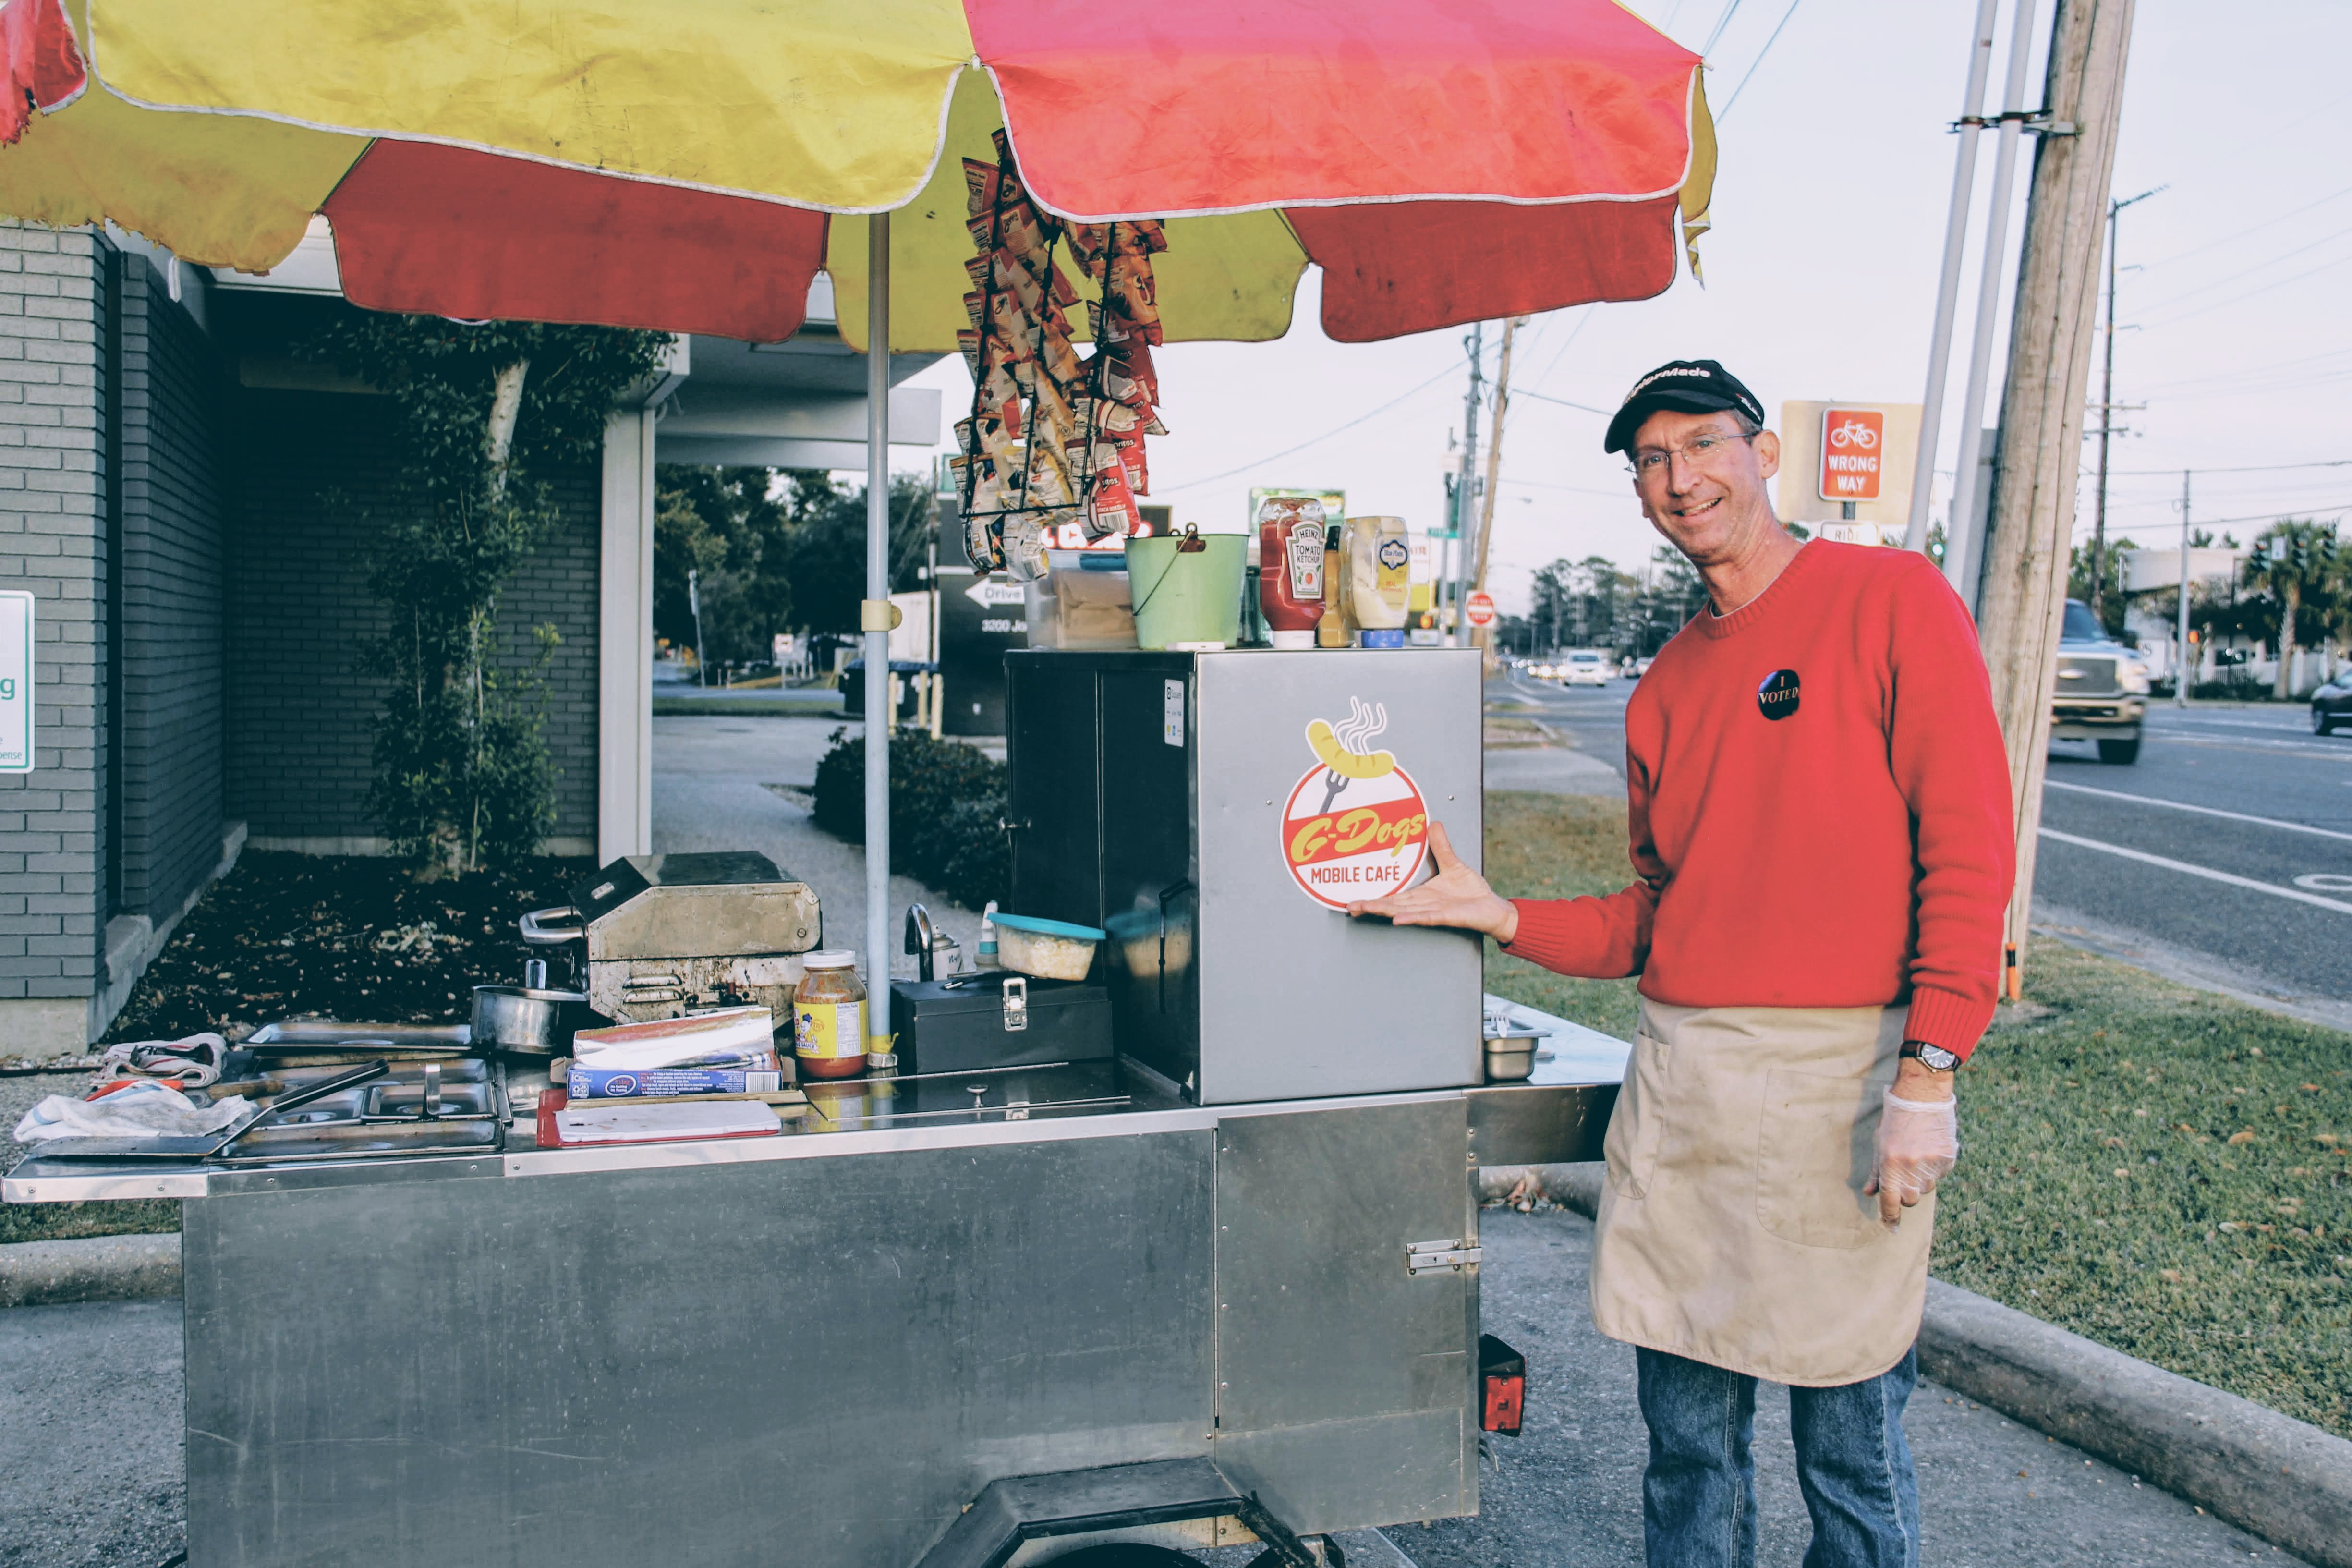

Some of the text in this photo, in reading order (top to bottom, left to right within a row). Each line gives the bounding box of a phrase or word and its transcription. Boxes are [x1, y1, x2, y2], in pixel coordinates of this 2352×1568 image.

[1828, 455, 1877, 472] WRONG
[1837, 476, 1866, 492] WAY
[1299, 530, 1318, 540] HEINZ
[1296, 545, 1320, 555] TOMATO
[1297, 555, 1320, 563] KETCHUP
[1781, 676, 1784, 687] I
[1758, 687, 1798, 704] VOTED
[1311, 861, 1400, 884] MOBILE CAFÉ
